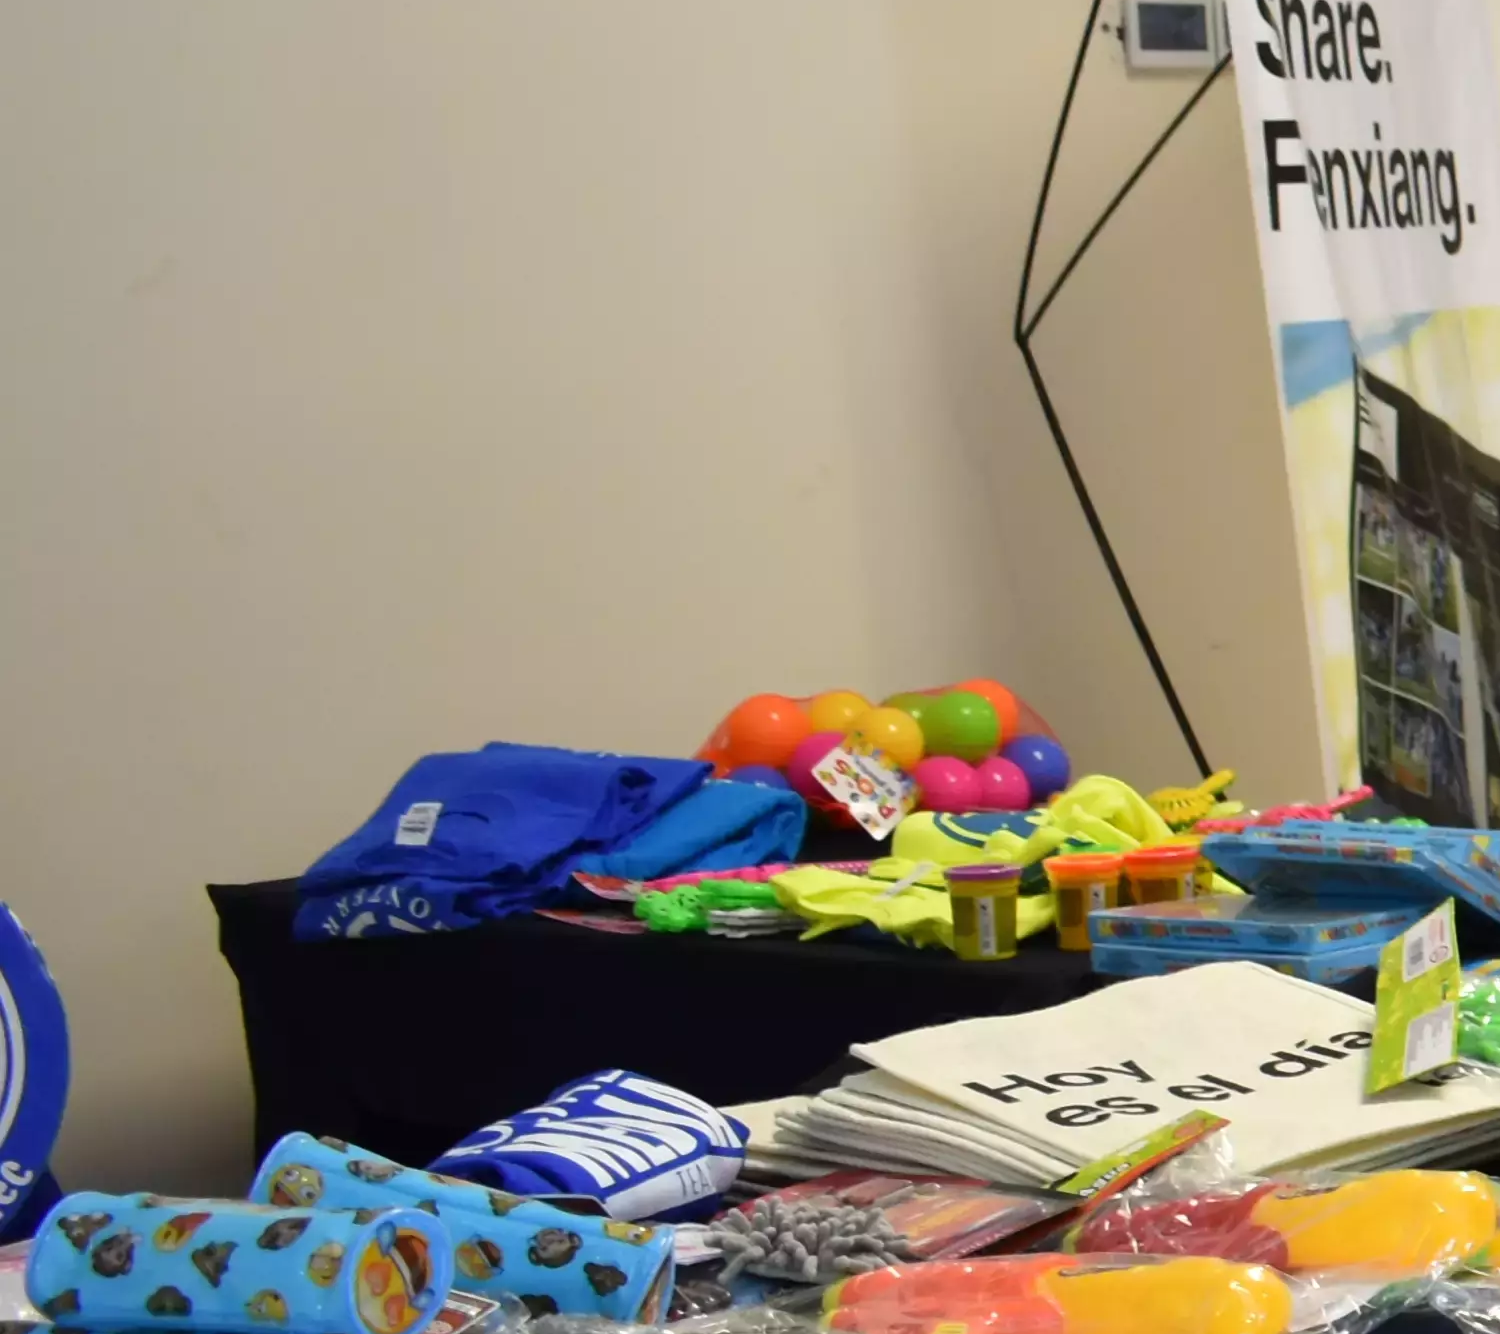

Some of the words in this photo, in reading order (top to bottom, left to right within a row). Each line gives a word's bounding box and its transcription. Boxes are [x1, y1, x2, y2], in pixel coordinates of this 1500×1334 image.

[961, 1058, 1156, 1105] Hoy
[1045, 1095, 1160, 1128] es
[1166, 1072, 1256, 1103] el
[1257, 1027, 1374, 1079] día
